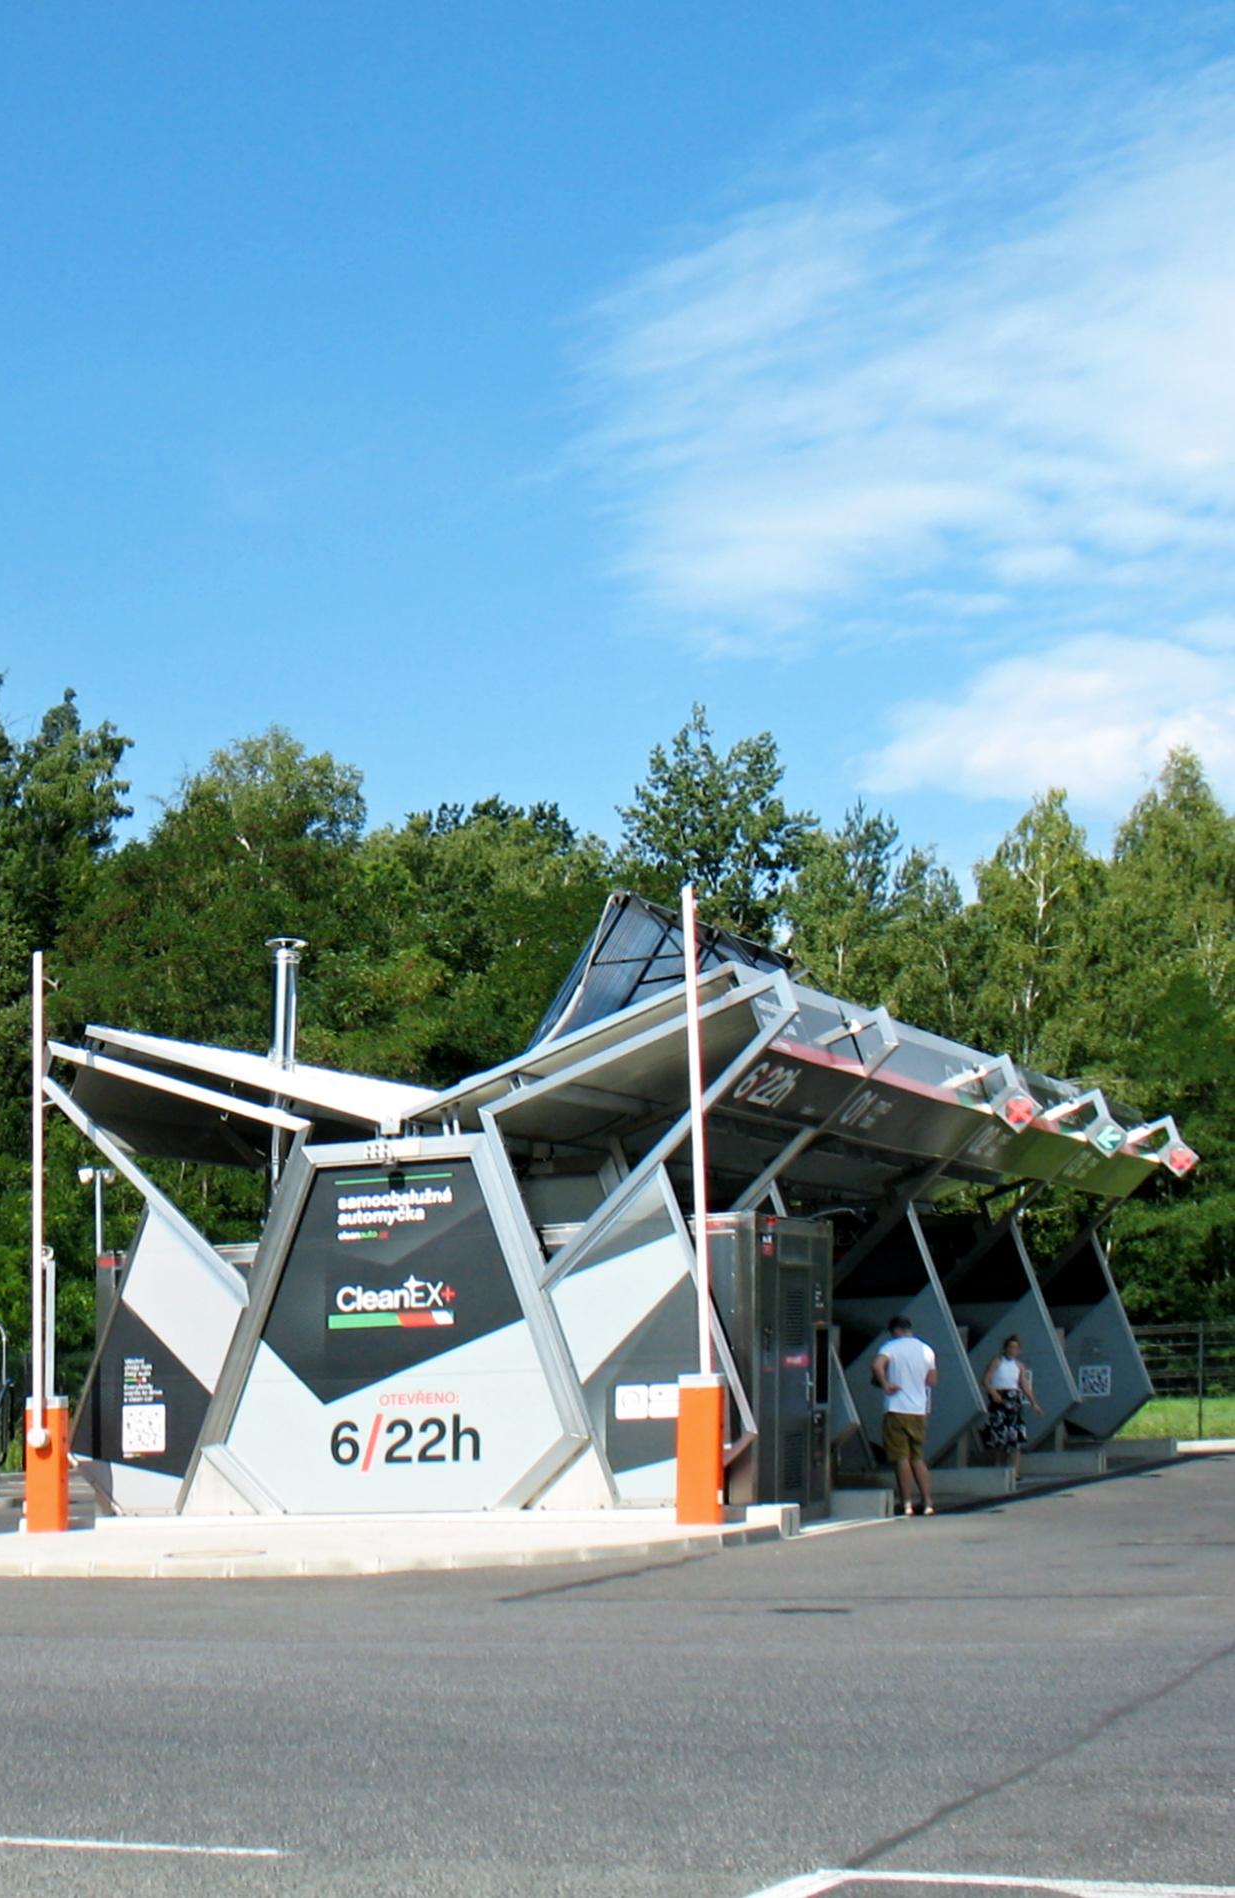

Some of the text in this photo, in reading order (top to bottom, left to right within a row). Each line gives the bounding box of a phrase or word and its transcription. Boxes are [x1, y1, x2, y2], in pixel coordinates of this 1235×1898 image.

[336, 1185, 453, 1212] samoobslužná
[336, 1204, 426, 1227] automyčka
[330, 1412, 481, 1472] 6/22h
